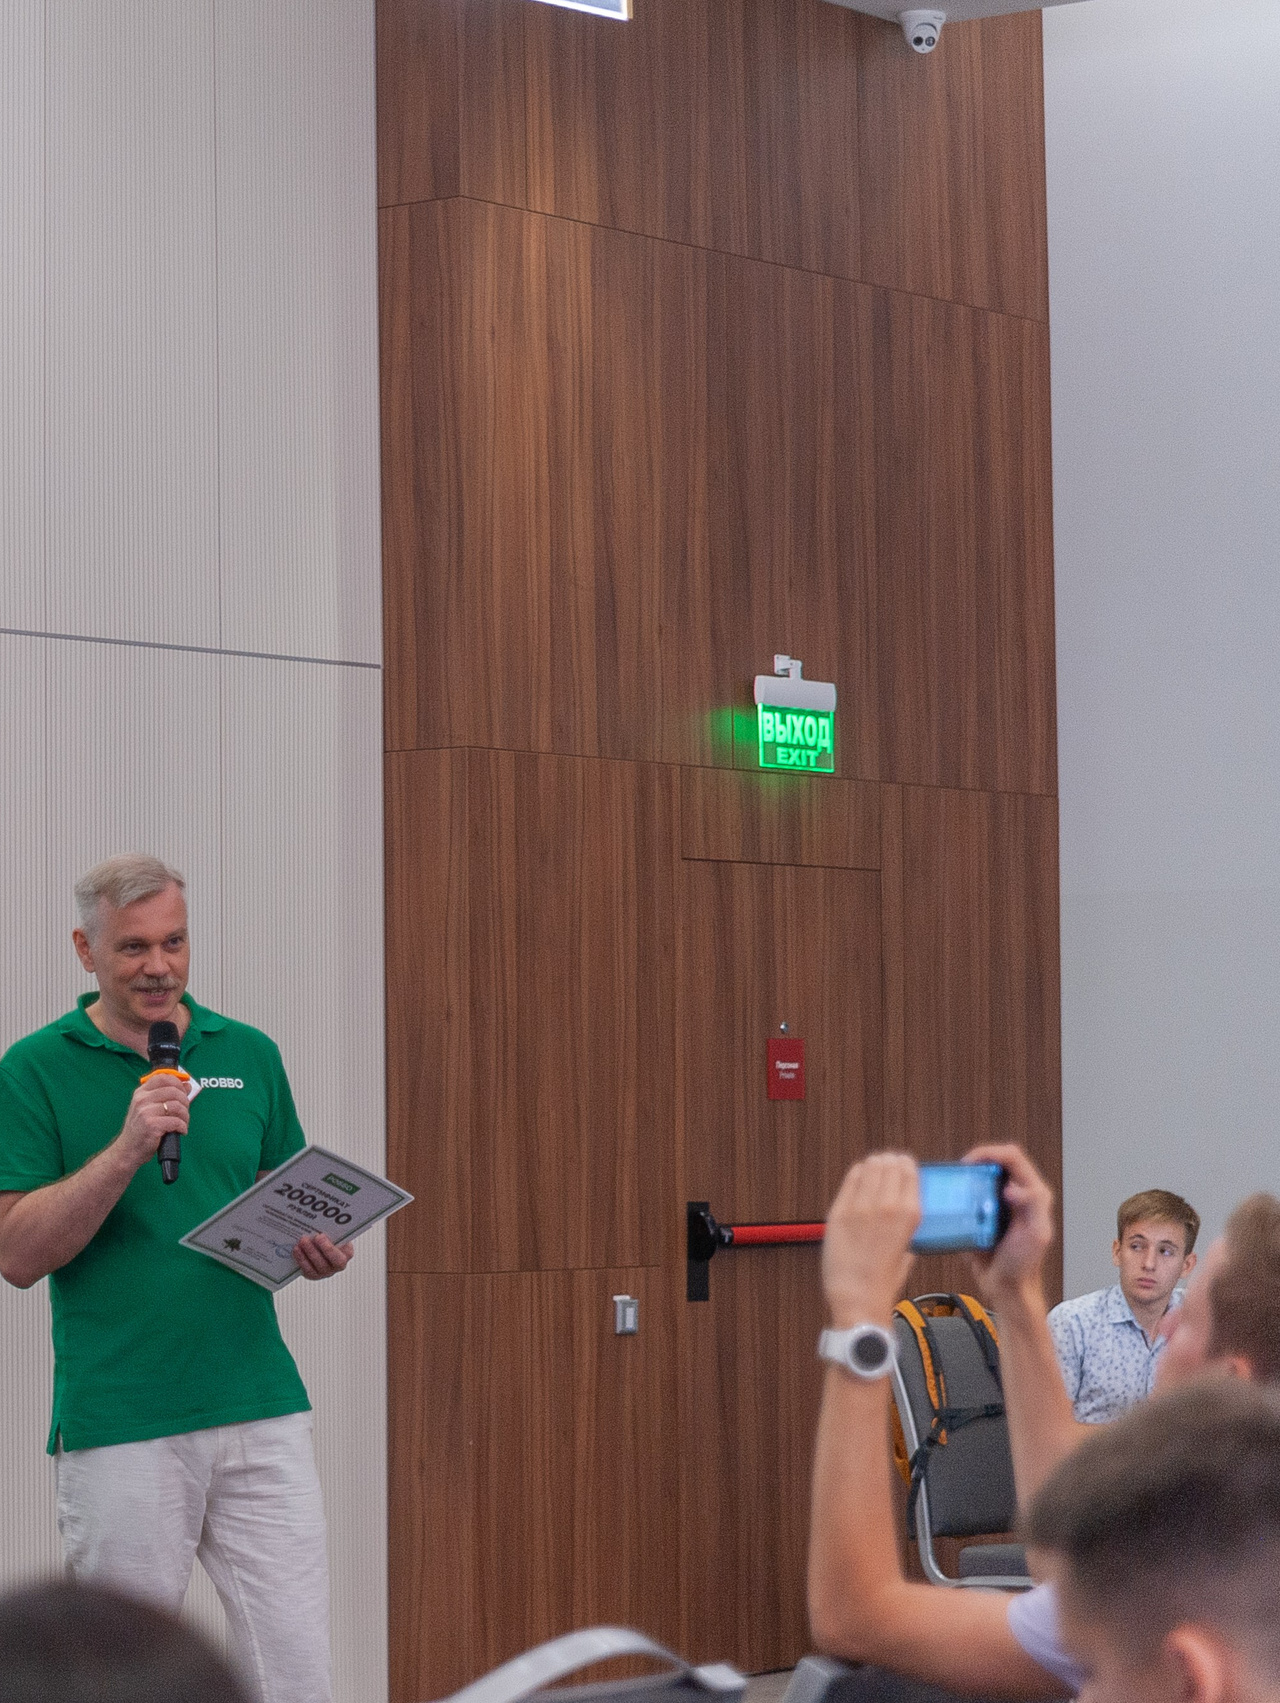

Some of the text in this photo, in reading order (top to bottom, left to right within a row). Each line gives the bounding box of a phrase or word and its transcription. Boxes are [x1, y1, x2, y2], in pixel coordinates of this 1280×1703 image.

[763, 711, 832, 754] ВЫХОД
[776, 747, 819, 767] EXIT
[199, 1077, 244, 1089] ROBBO
[273, 1182, 353, 1226] 200000
